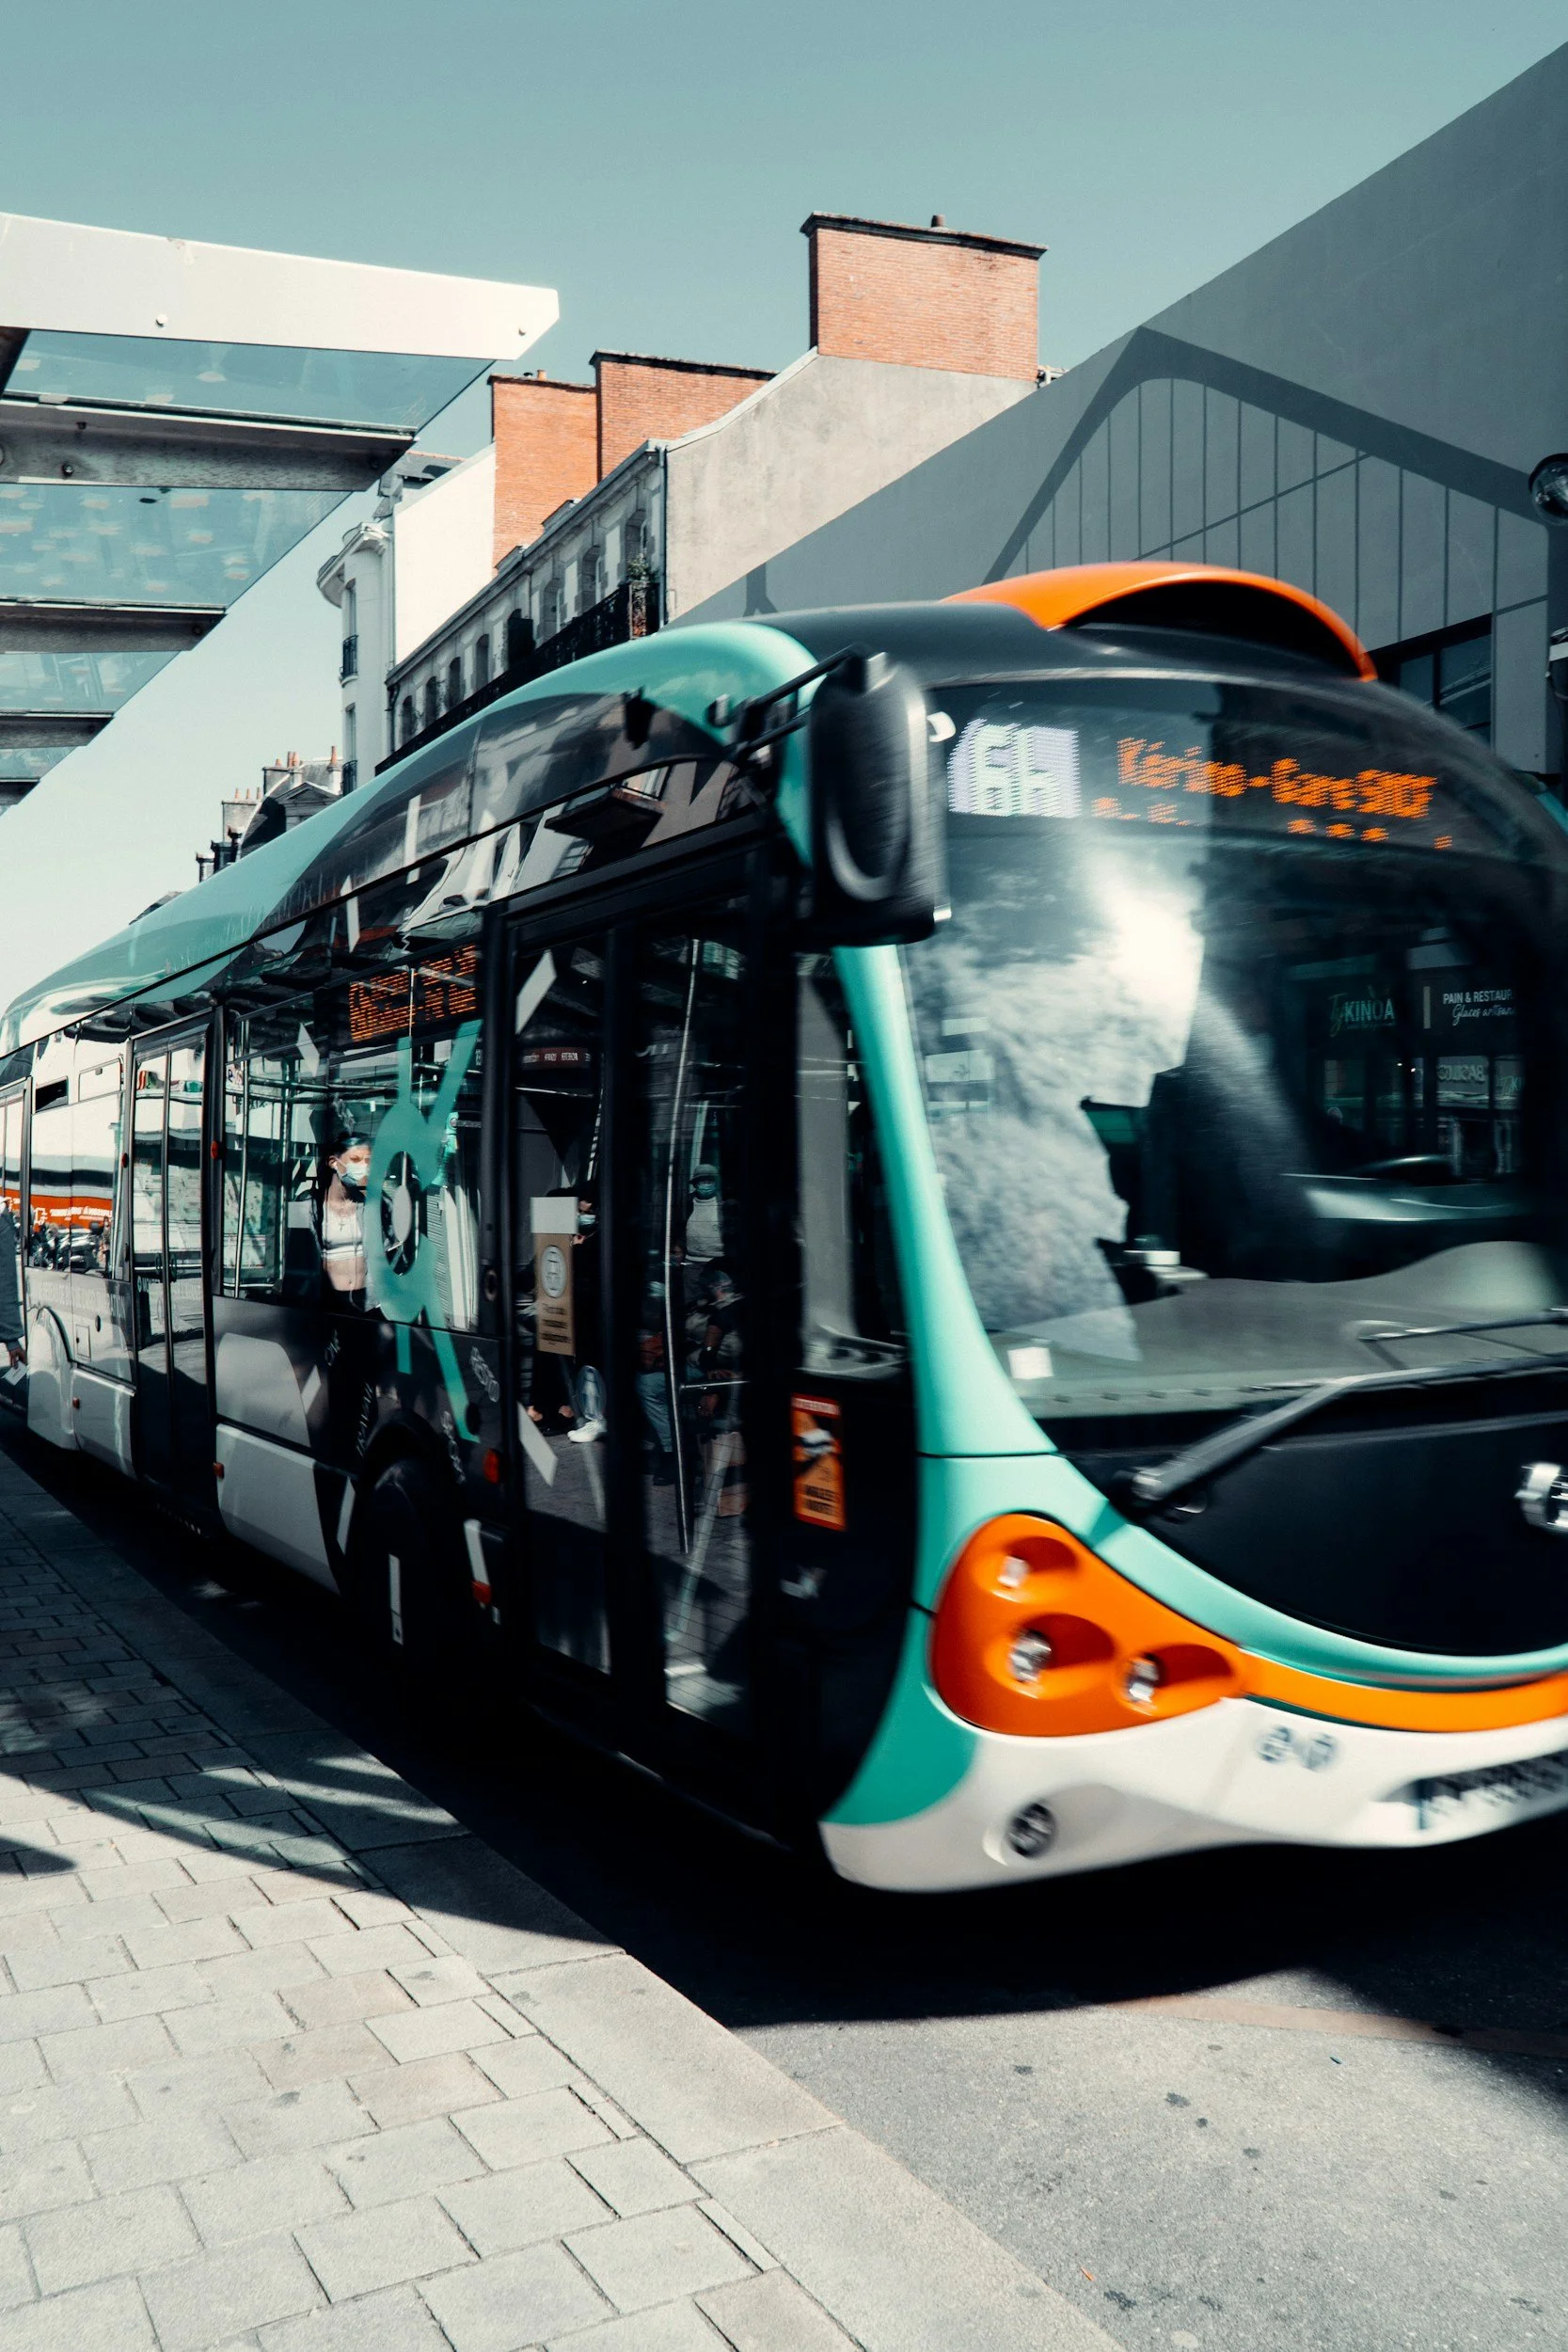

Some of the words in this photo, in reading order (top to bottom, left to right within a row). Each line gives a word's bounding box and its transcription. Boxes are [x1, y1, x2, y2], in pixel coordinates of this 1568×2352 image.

[1442, 992, 1463, 1005] PAIN
[1465, 992, 1472, 1003] &
[1344, 998, 1395, 1023] KINOA
[1451, 1004, 1481, 1026] Glaces
